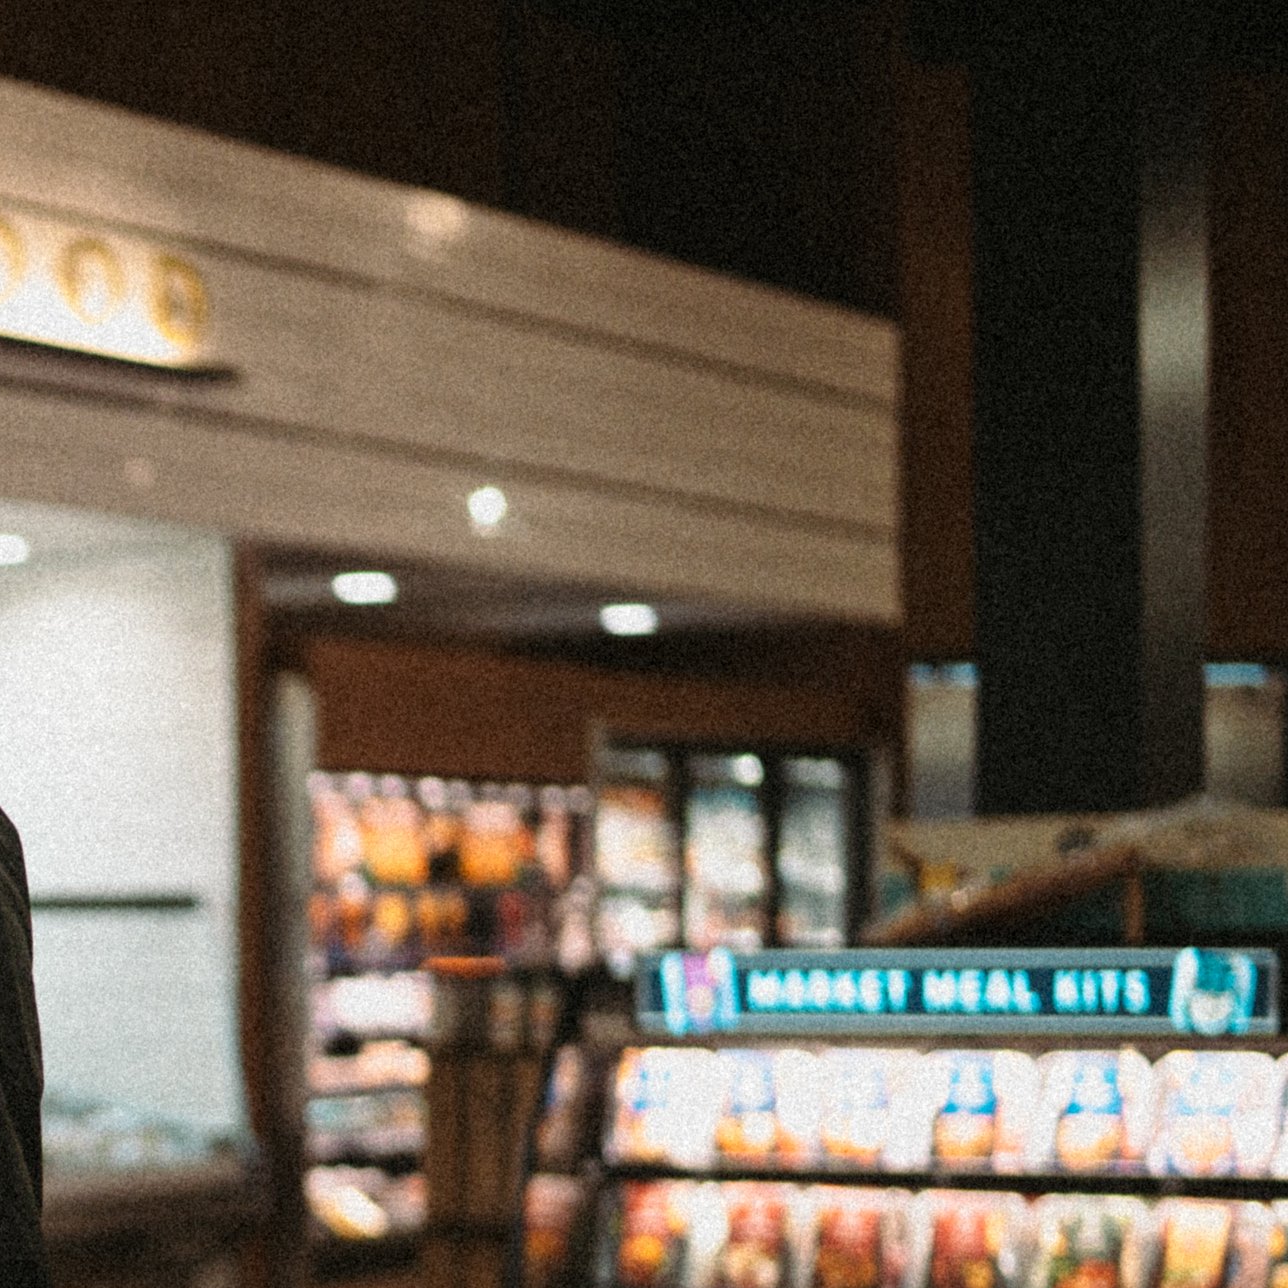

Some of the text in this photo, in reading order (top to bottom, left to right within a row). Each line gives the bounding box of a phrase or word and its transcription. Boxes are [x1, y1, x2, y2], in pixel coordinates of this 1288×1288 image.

[745, 968, 1151, 1014] MARKET MEAL KITS
